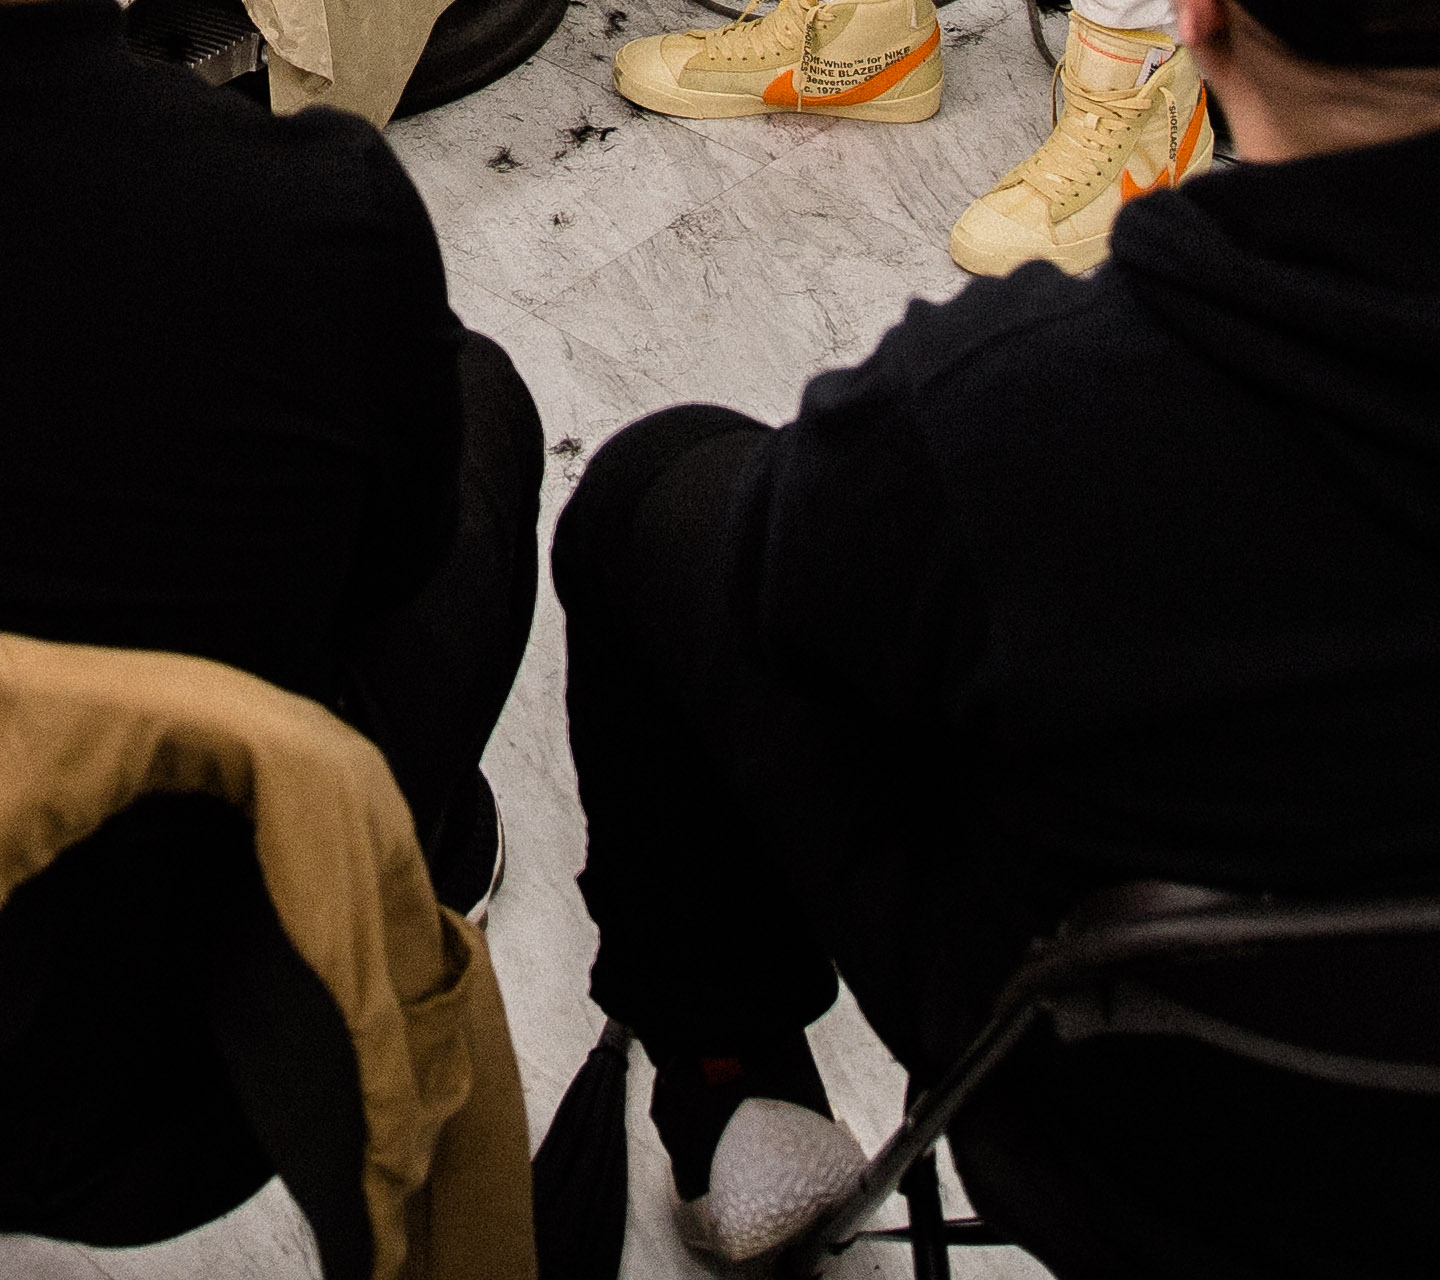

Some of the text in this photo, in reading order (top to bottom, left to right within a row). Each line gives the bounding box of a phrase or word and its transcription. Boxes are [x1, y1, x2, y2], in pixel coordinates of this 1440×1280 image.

[867, 56, 881, 65] for
[884, 45, 911, 61] NIKE
[809, 65, 836, 78] NIKE
[838, 64, 883, 78] BLAZER
[816, 86, 842, 95] 1972
